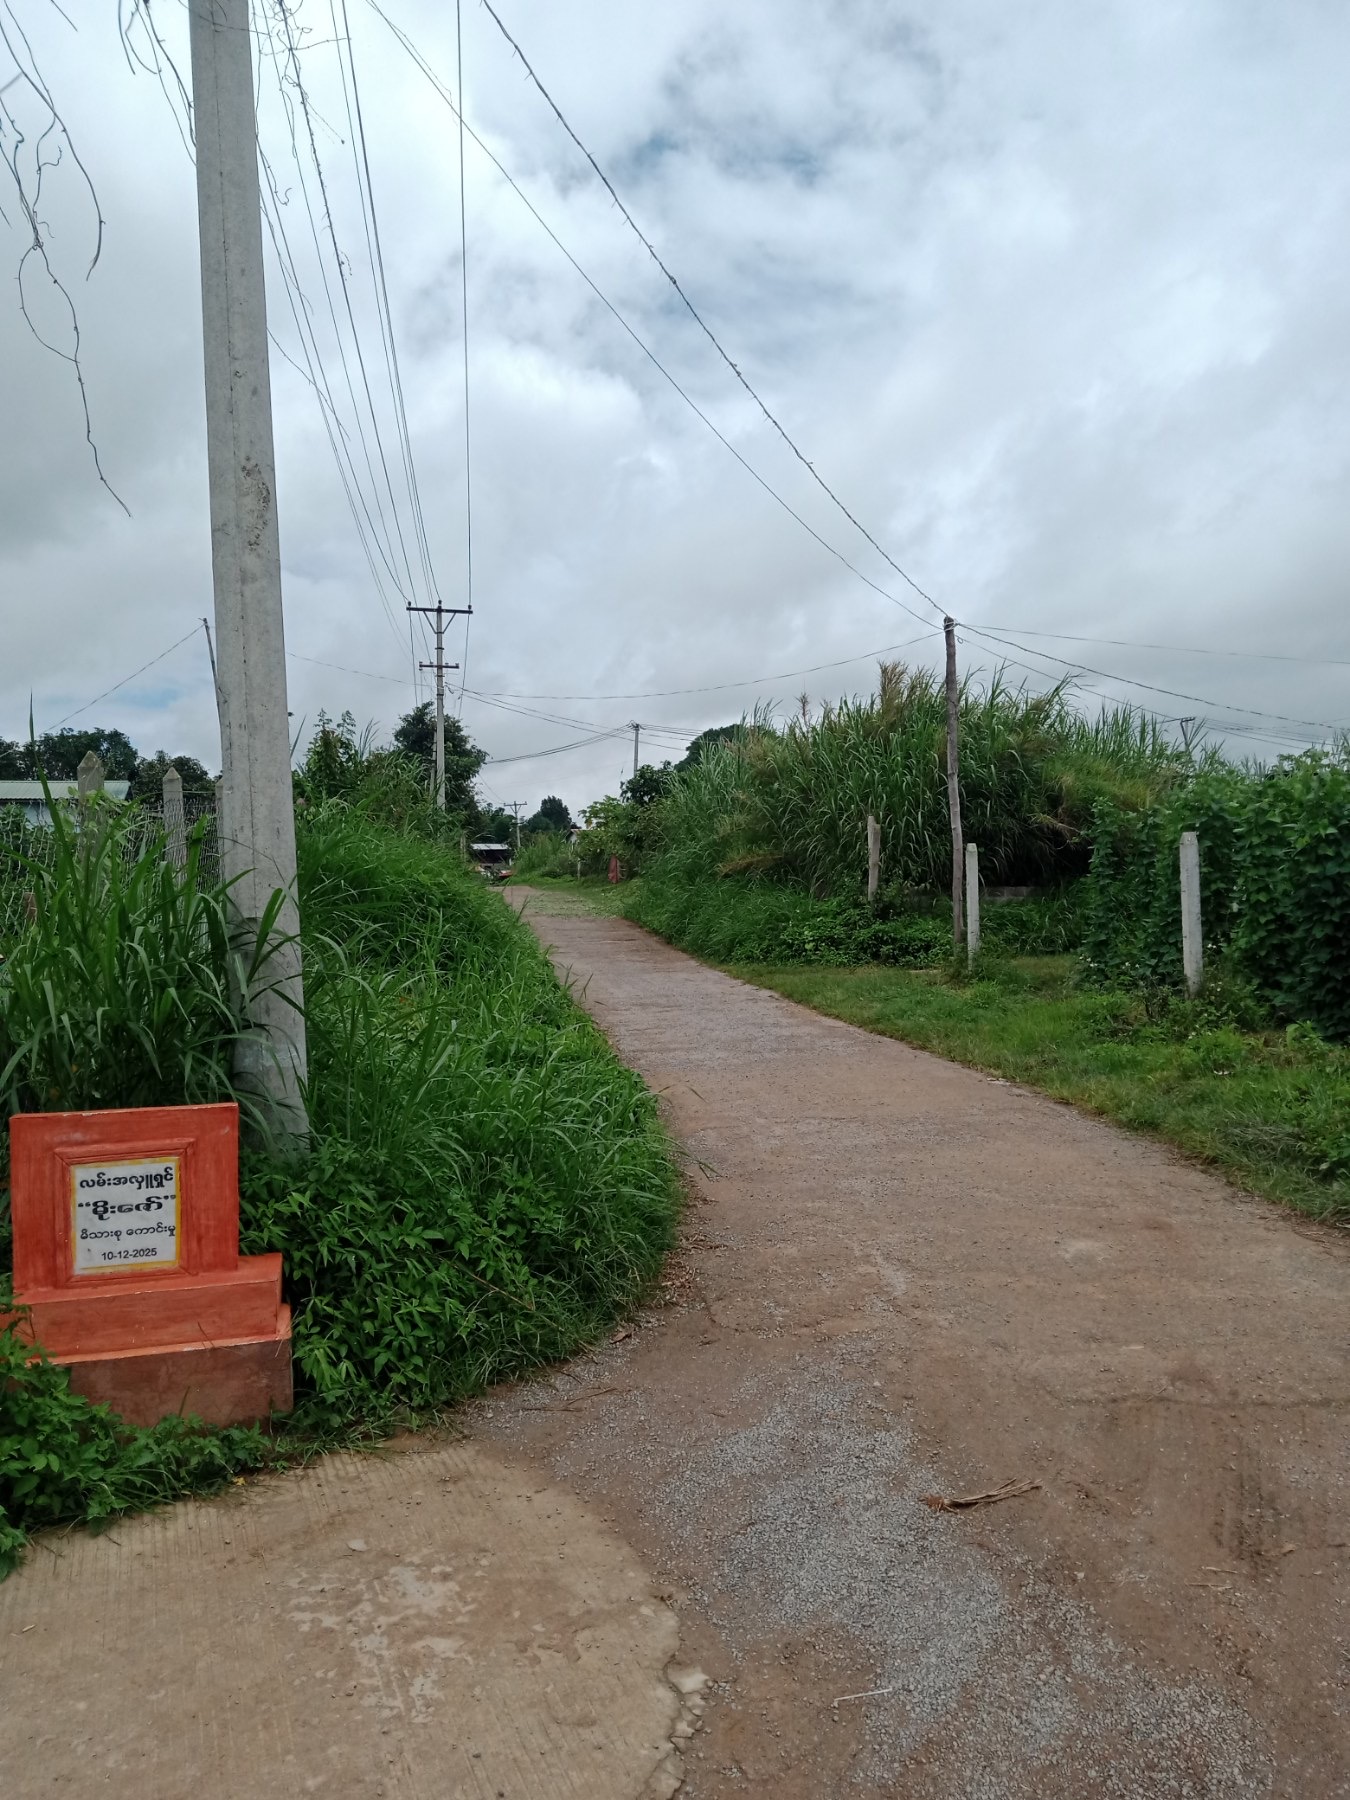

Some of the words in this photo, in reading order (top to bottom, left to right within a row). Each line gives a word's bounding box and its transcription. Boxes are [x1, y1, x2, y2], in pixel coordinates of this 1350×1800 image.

[80, 1228, 122, 1241] မိသားစု
[126, 1221, 176, 1237] ကောင်းမှု
[101, 1247, 158, 1261] 10-12-2025
